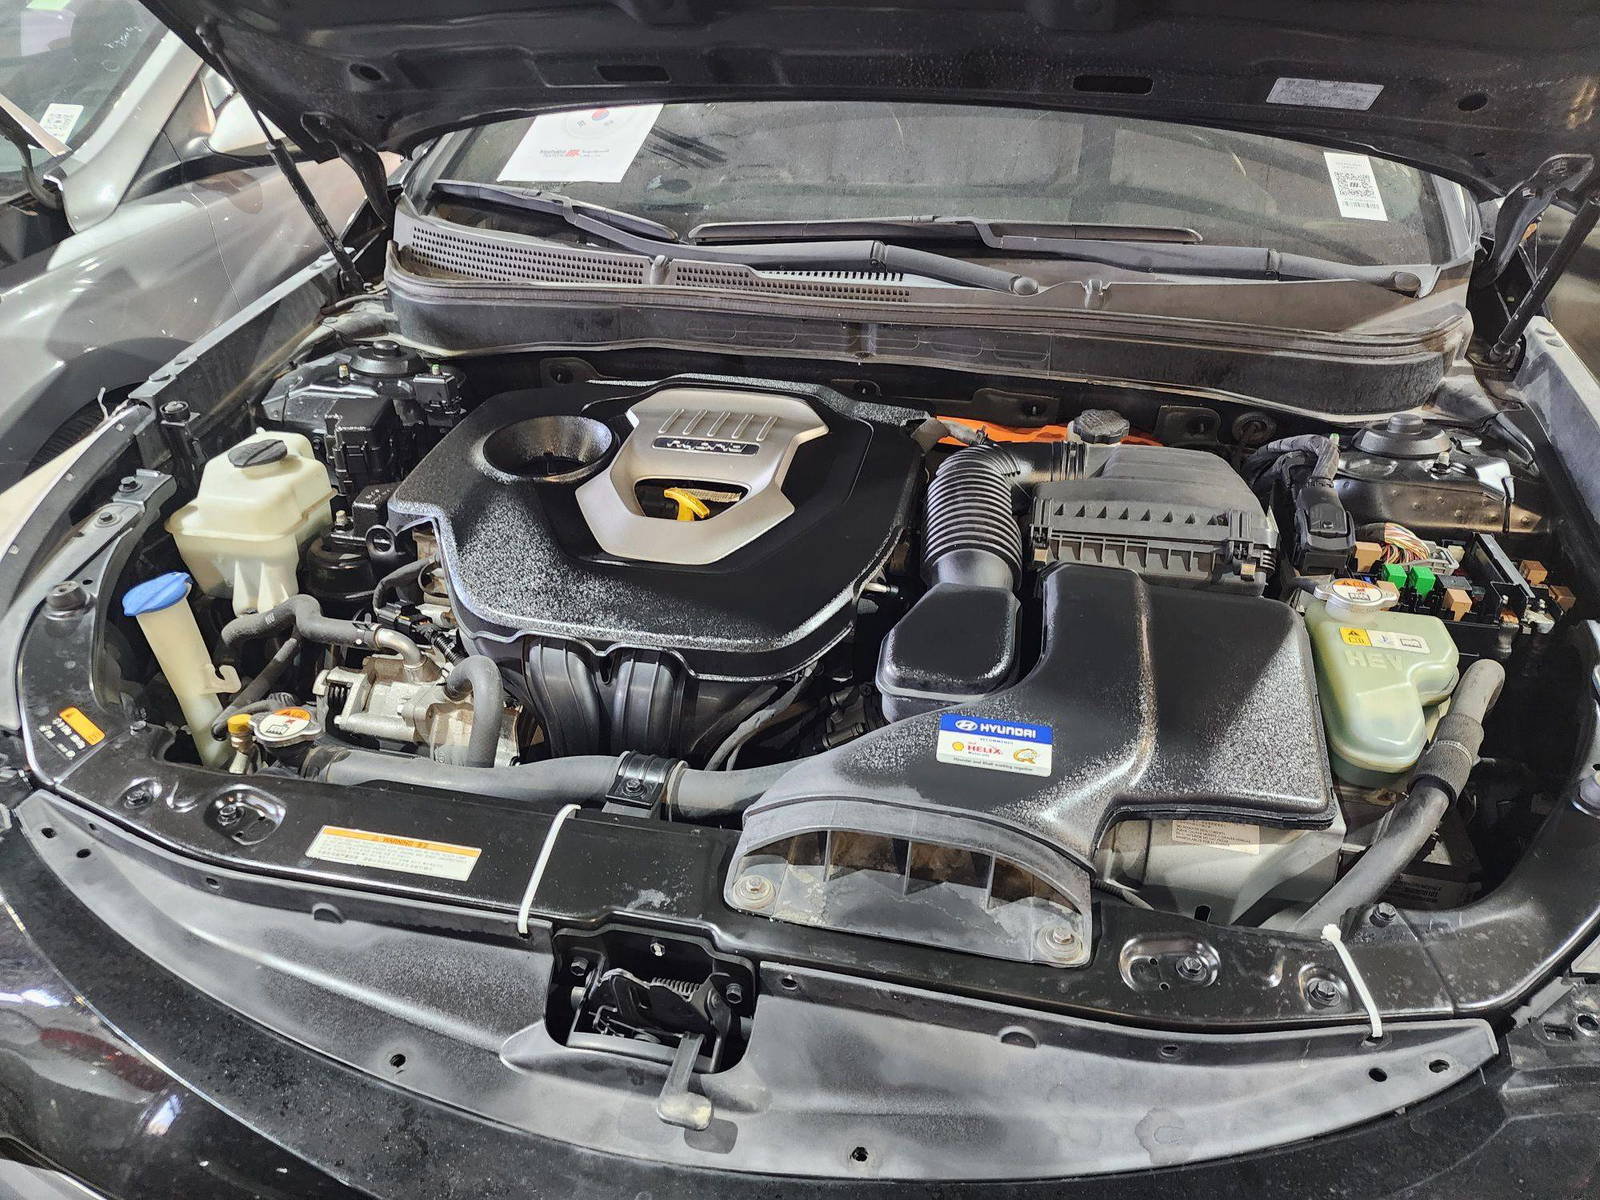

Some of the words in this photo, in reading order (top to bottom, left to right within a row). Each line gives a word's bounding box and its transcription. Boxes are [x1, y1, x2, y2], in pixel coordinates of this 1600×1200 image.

[1344, 650, 1404, 671] HEV
[980, 723, 1037, 738] HYUNDAI
[968, 745, 1001, 755] HELIX
